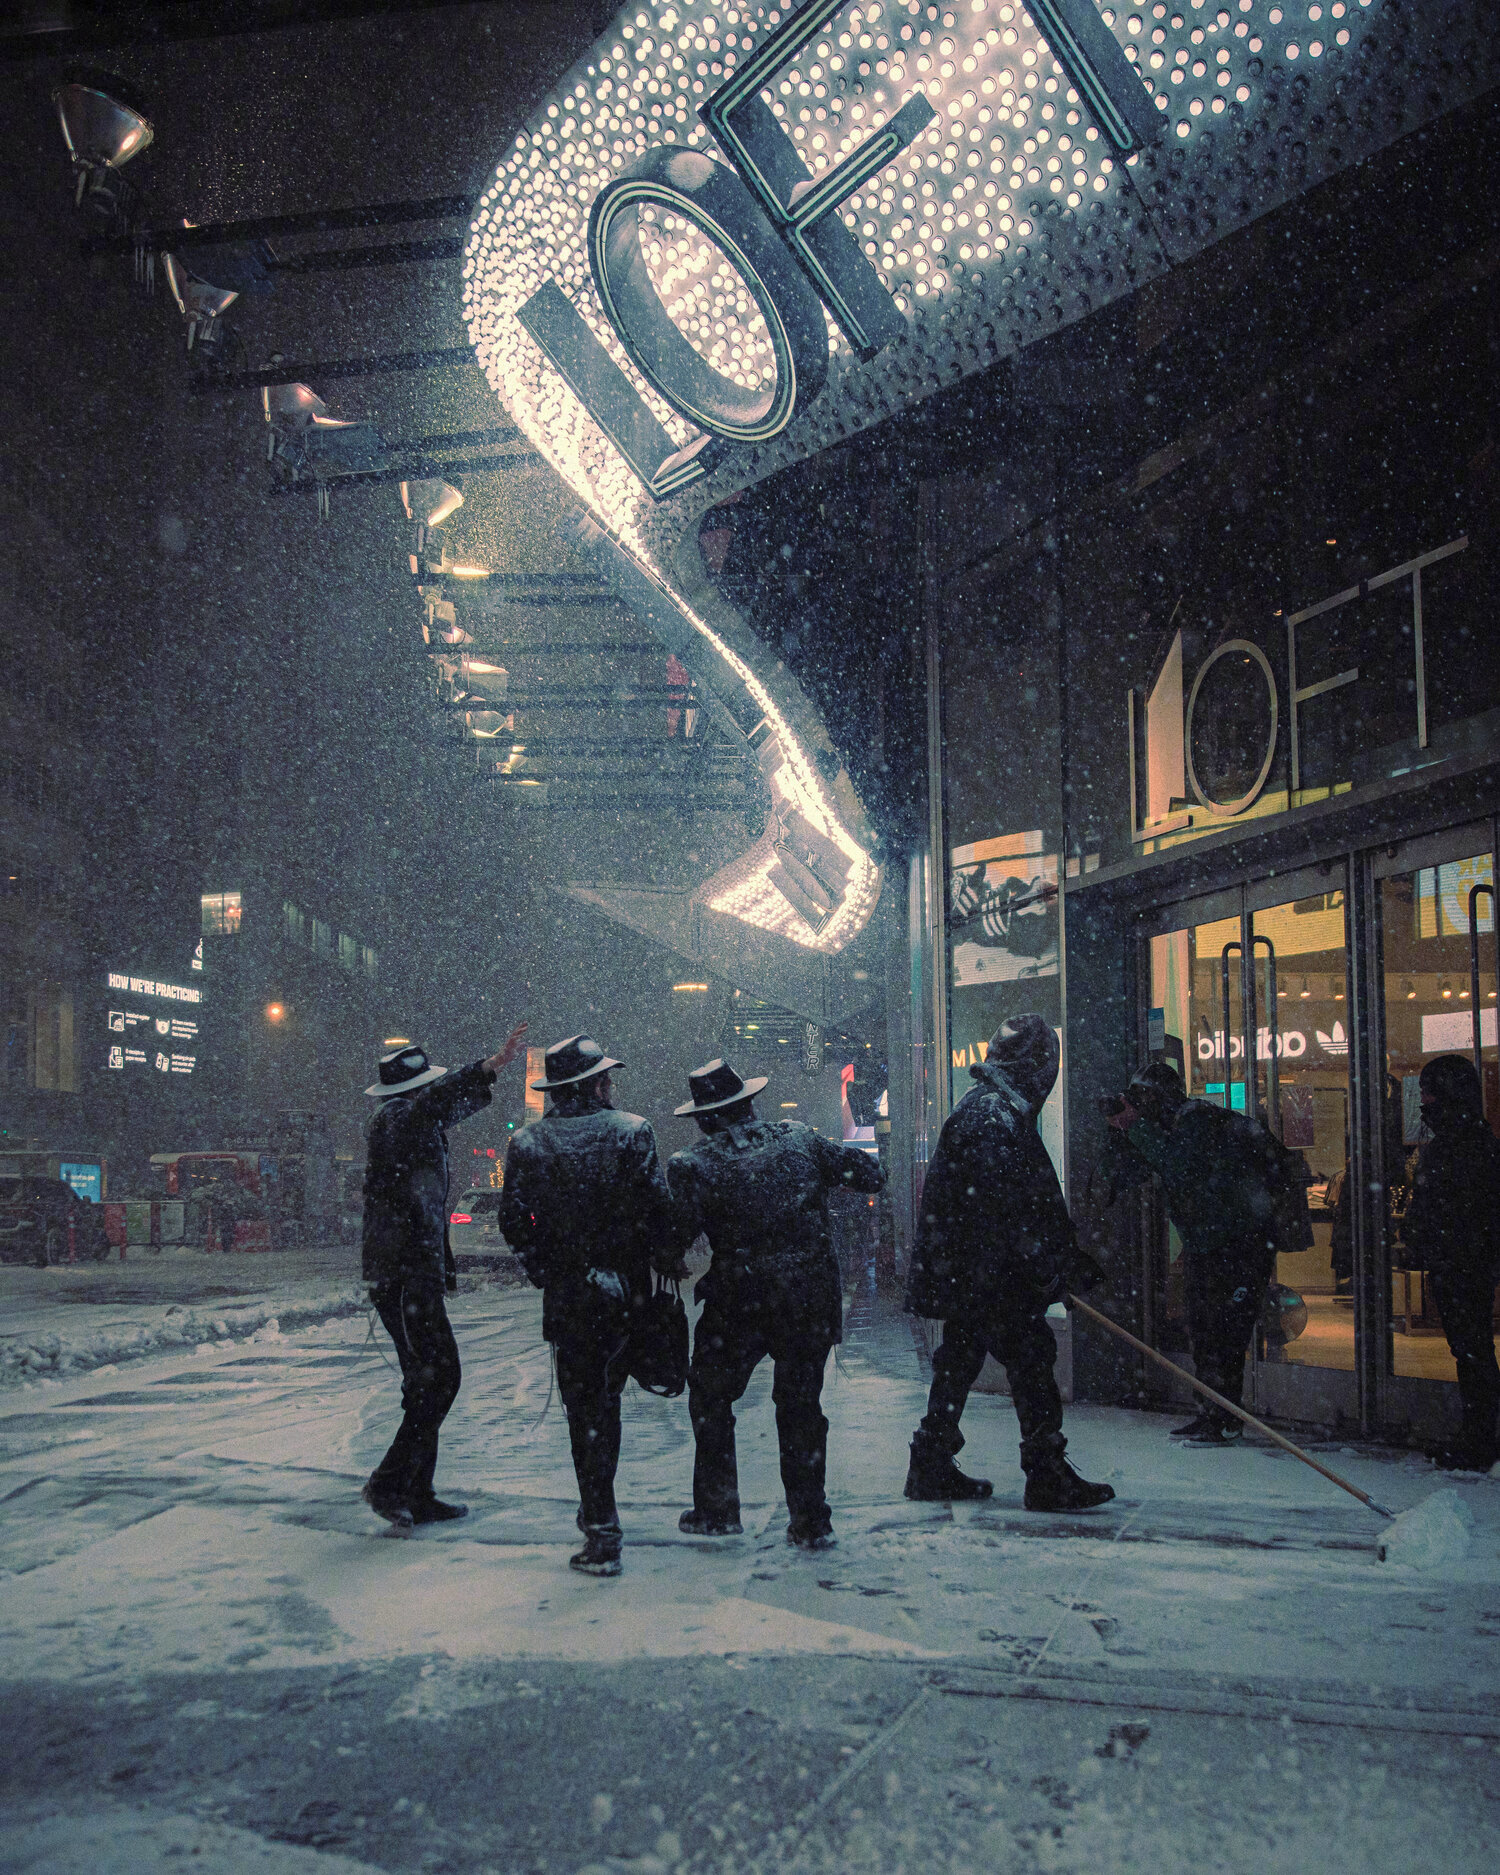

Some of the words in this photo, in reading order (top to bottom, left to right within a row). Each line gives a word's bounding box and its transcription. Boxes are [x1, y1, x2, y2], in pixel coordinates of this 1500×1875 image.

[1128, 535, 1469, 844] LOFT
[109, 973, 129, 989] HOW
[130, 978, 155, 994] WE'RE
[156, 983, 200, 1002] PRACTICING
